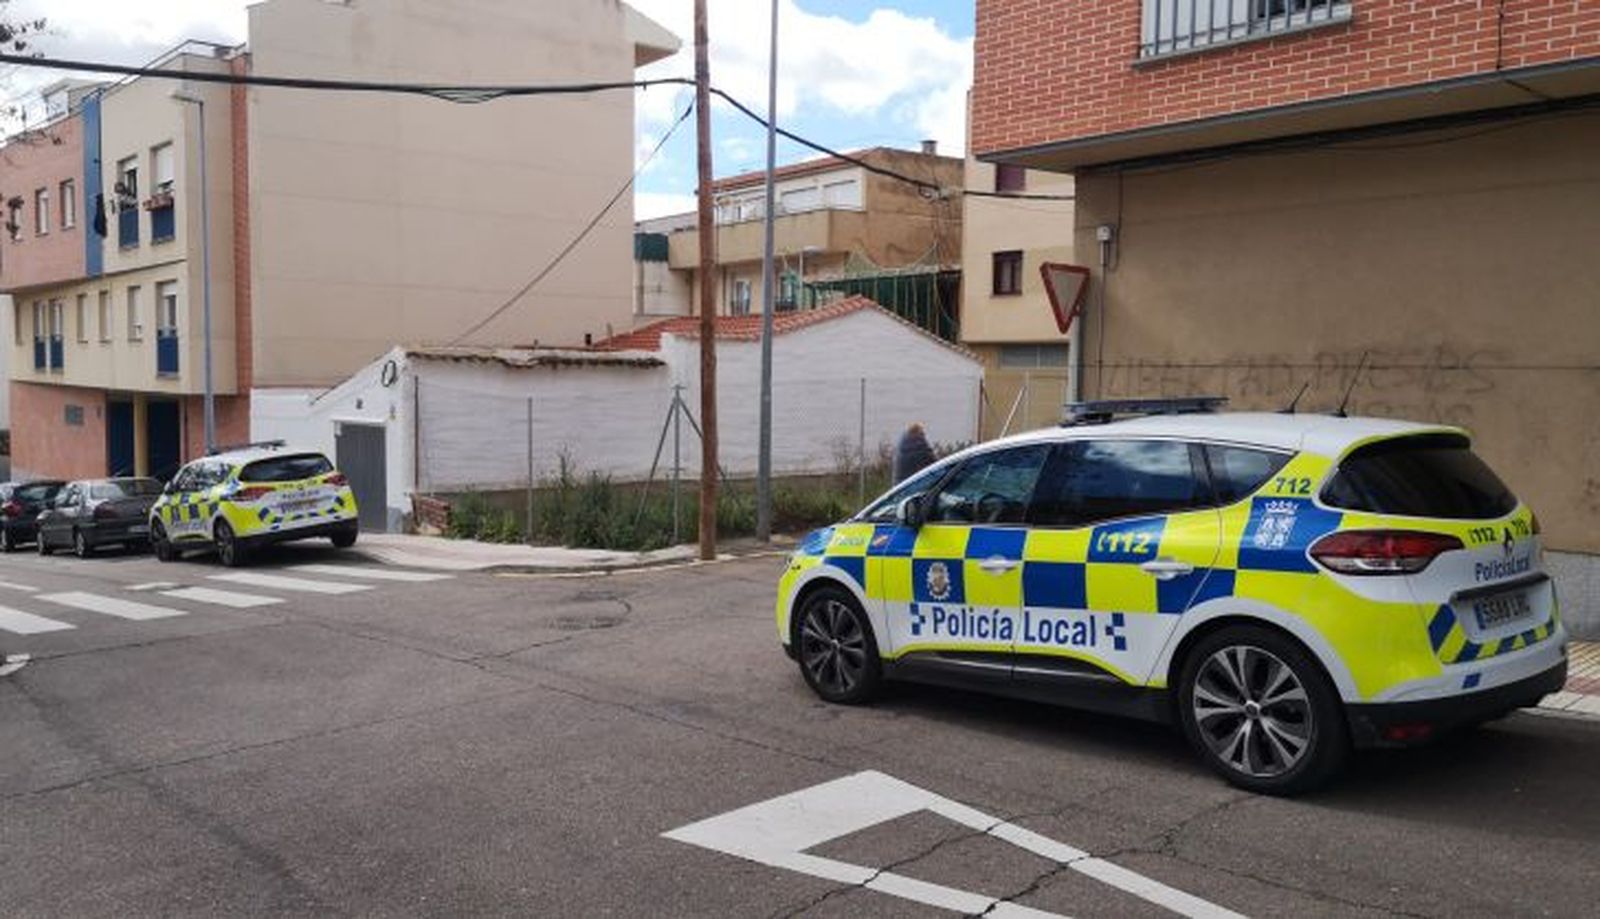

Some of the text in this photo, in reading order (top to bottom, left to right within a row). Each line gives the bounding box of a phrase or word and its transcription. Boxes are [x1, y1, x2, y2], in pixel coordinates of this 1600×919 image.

[1275, 477, 1311, 494] 712
[1108, 531, 1151, 554] 112
[932, 606, 1097, 647] Policía Local
